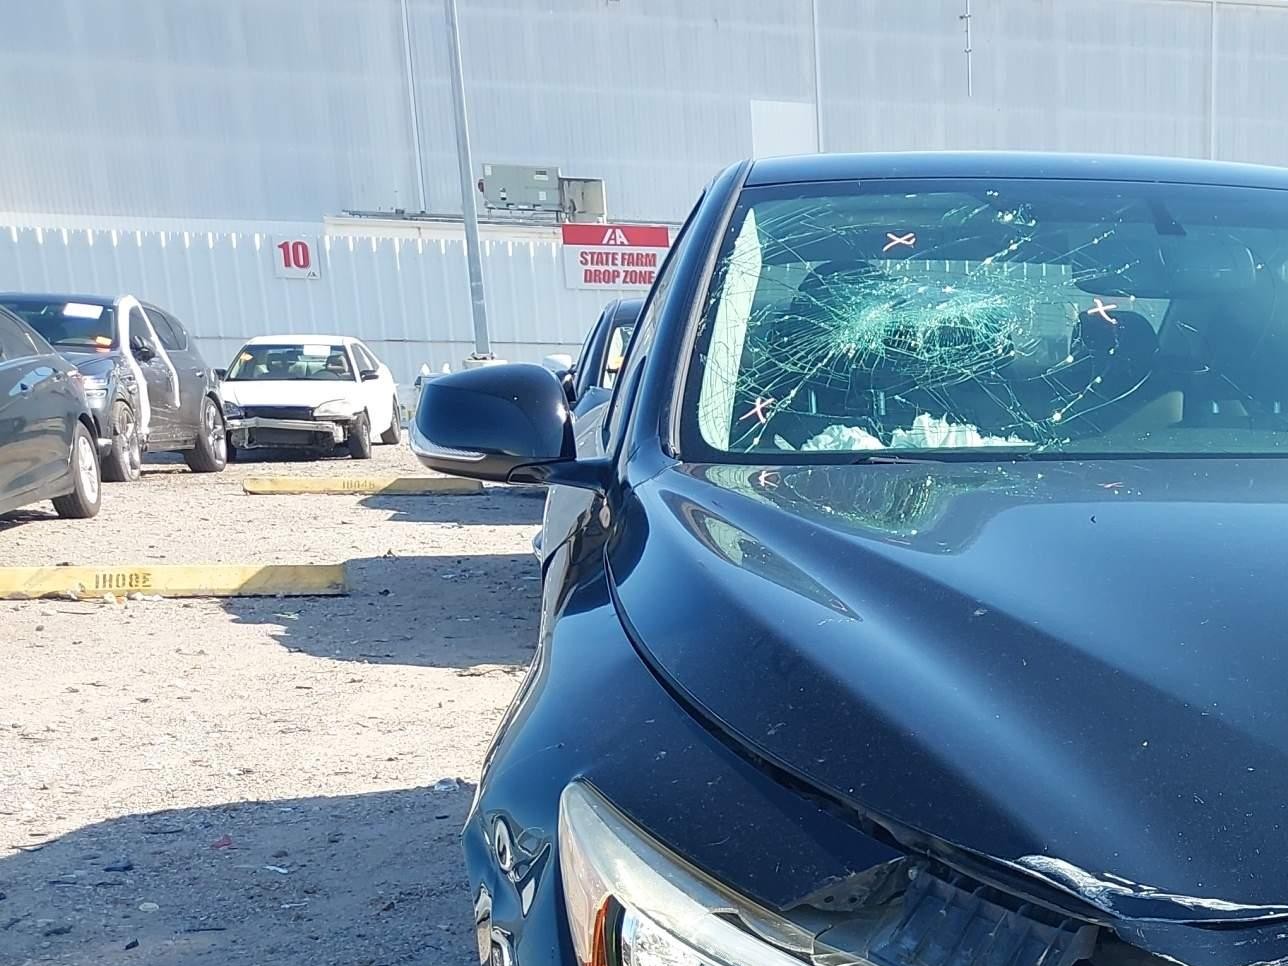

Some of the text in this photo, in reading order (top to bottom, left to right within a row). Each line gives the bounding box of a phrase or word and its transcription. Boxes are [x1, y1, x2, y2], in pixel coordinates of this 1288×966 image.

[277, 241, 310, 268] 10
[580, 251, 657, 268] STATE FARM
[584, 269, 656, 285] DROP ZONE
